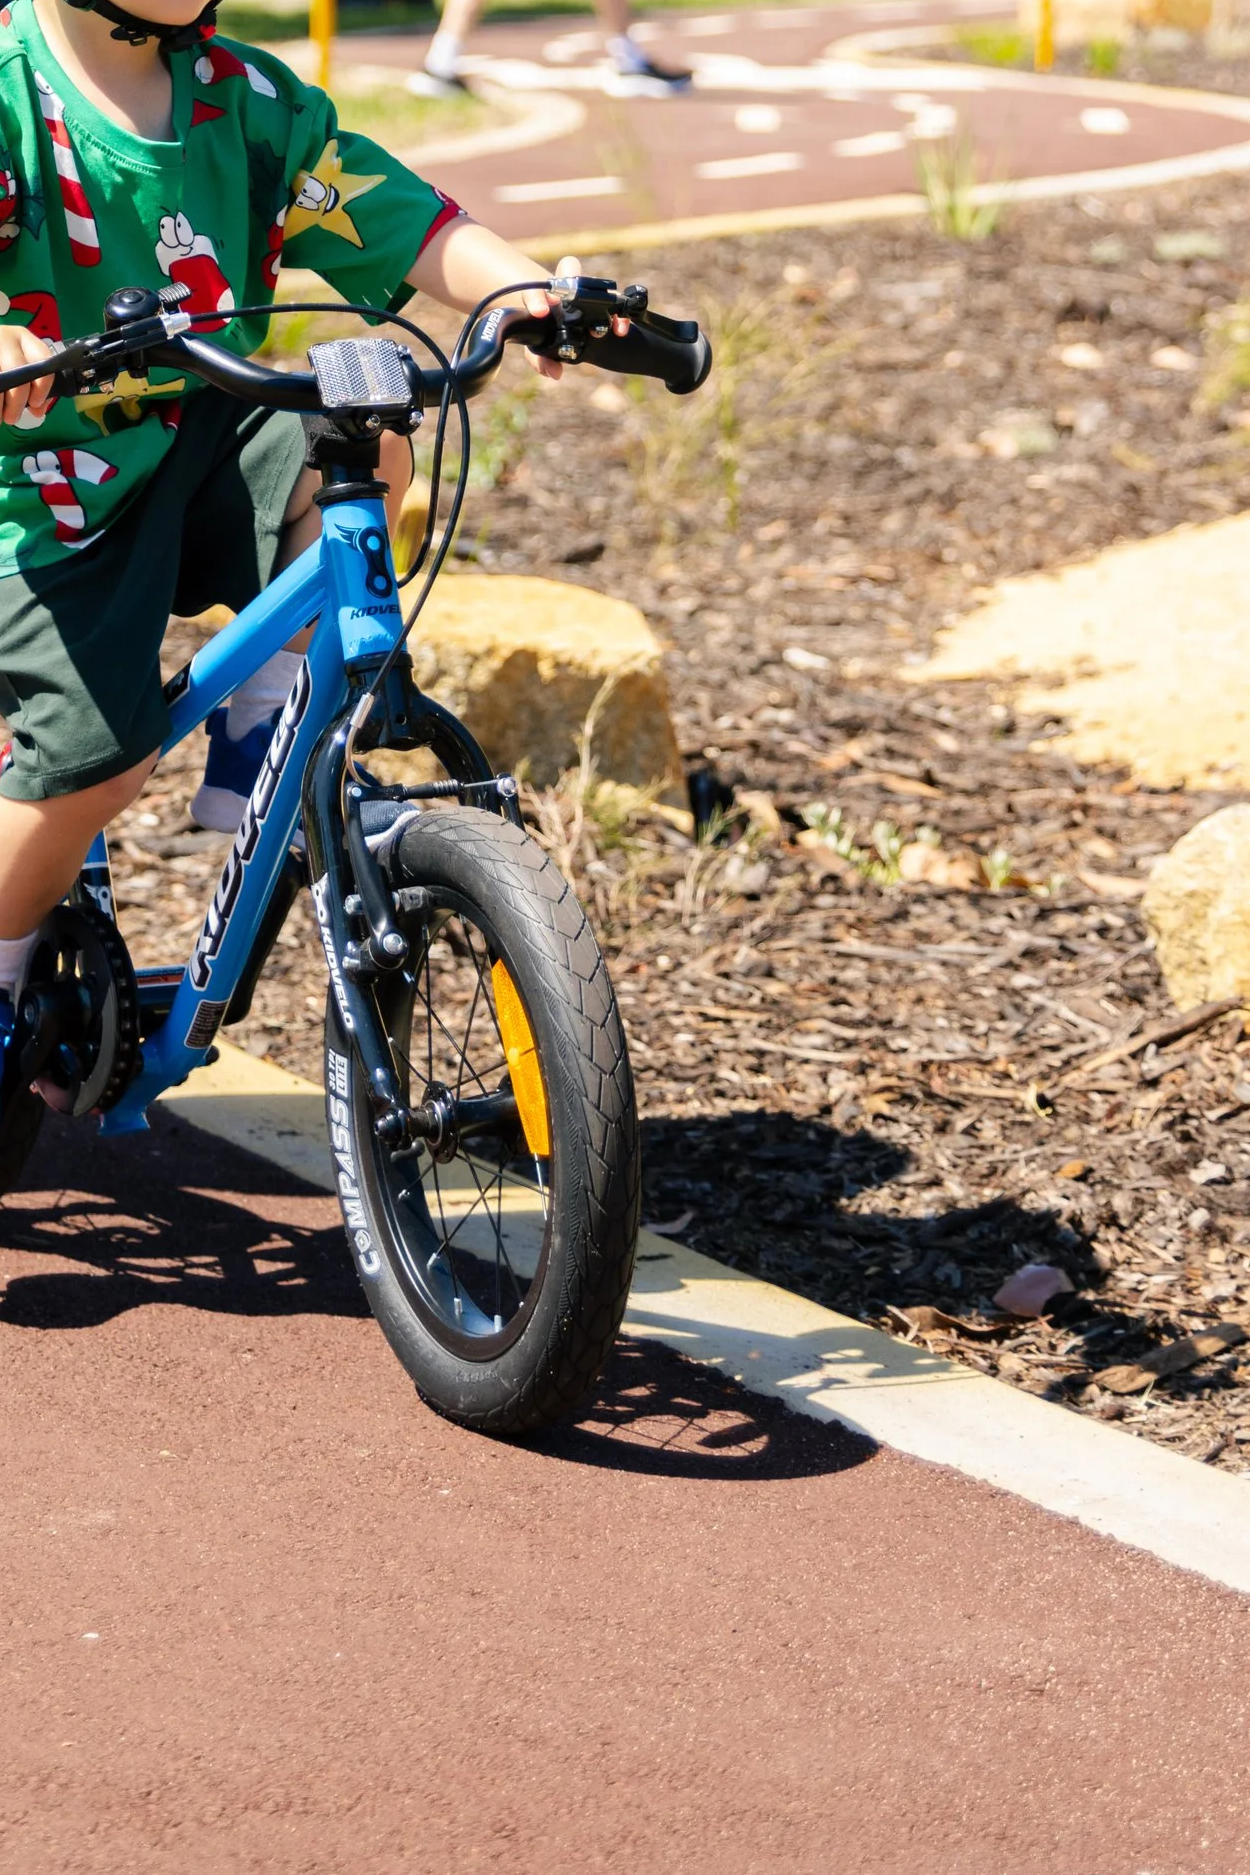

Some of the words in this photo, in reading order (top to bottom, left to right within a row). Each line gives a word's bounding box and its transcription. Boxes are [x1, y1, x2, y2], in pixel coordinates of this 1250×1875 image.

[480, 308, 504, 342] KIDVELO
[350, 605, 402, 620] KIDVEL
[190, 654, 311, 992] KIDVELO
[321, 926, 354, 1029] KIDVELO
[328, 1048, 337, 1070] TPI
[336, 1059, 346, 1091] LITE
[328, 1071, 337, 1091] 30
[329, 1095, 380, 1276] COMPASS
